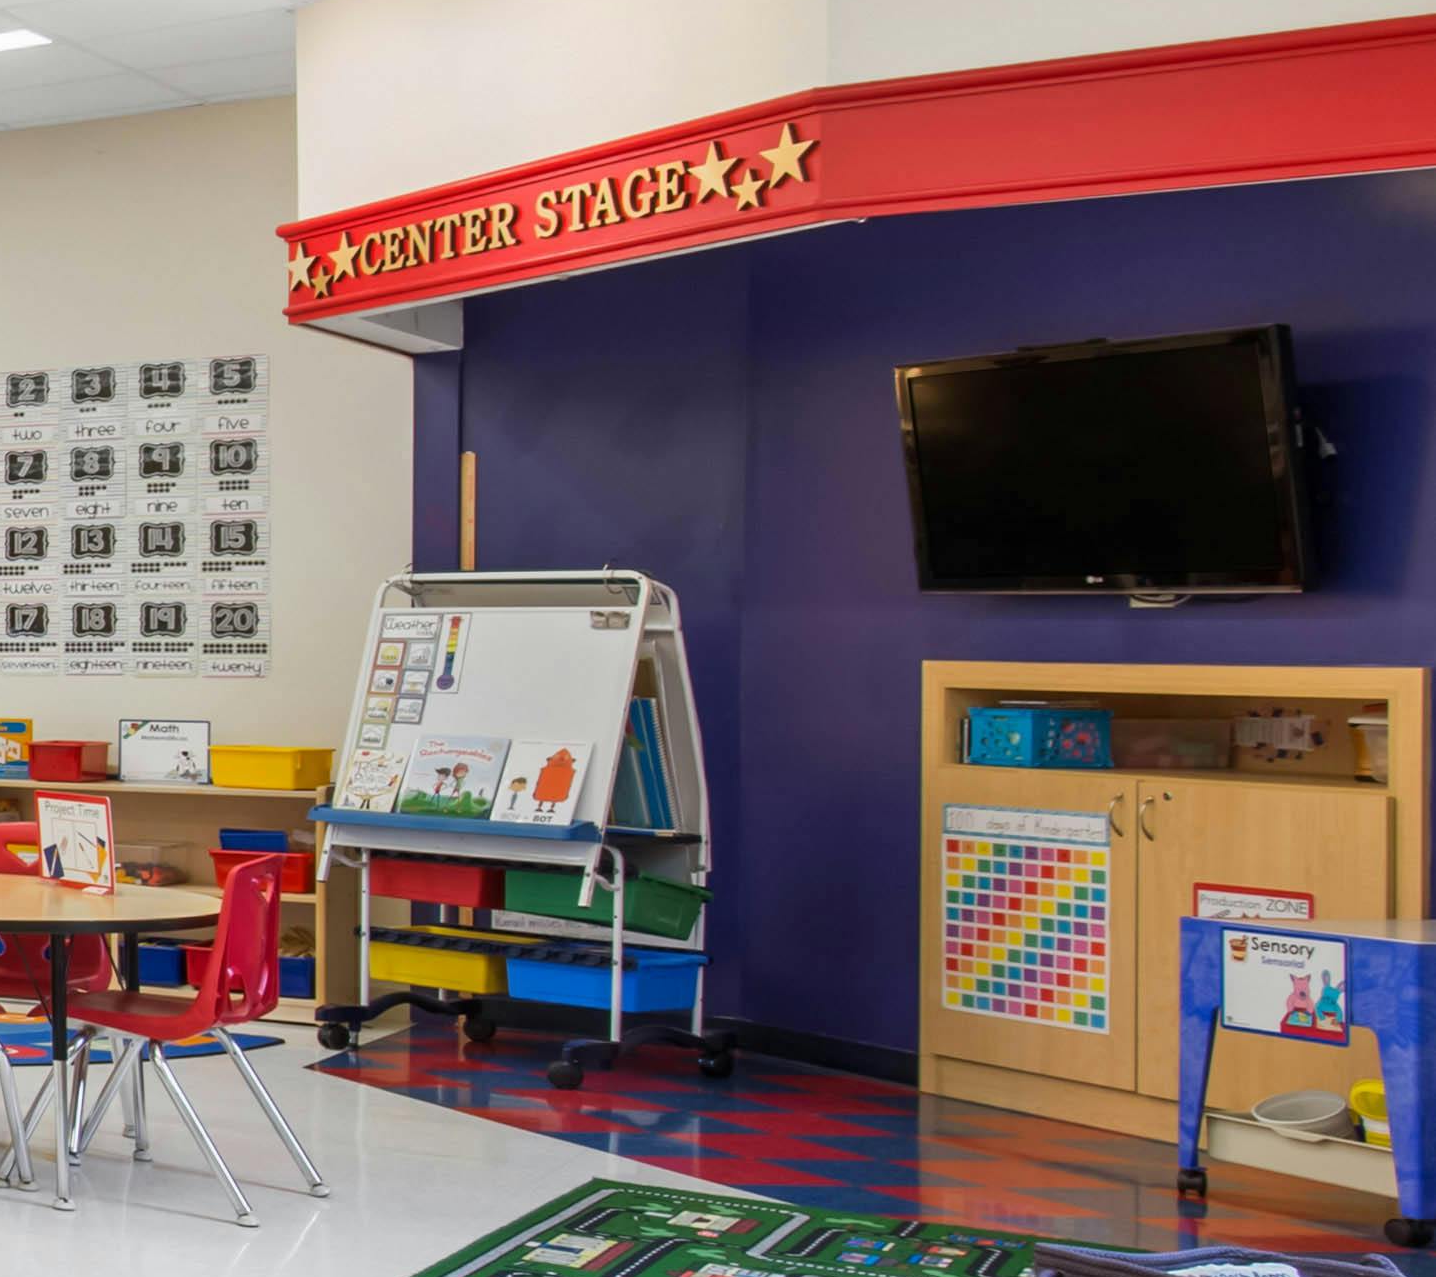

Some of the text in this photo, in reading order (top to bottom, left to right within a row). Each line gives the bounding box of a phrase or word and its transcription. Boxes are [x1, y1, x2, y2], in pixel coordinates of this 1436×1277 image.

[358, 160, 690, 276] CENTER STAGE
[84, 374, 101, 395] 3
[152, 369, 169, 391] 4
[222, 364, 241, 388] 5
[18, 378, 36, 401] 2
[75, 423, 116, 438] three
[146, 420, 178, 434] four
[218, 416, 250, 431] five
[11, 428, 42, 441] two
[83, 452, 100, 474] 8
[152, 449, 170, 471] 9
[219, 444, 247, 468] 10
[18, 455, 35, 478] 7
[4, 506, 50, 519] seven
[76, 502, 111, 519] eight
[147, 500, 178, 513] nine
[221, 498, 249, 511] ten
[13, 533, 37, 555] 12
[80, 530, 103, 552] 13
[147, 528, 174, 550] 14
[221, 525, 246, 549] 15
[3, 582, 53, 595] twelve
[69, 579, 120, 593] thirteen
[135, 579, 191, 592] fourteen
[211, 579, 259, 592] fifteen
[13, 609, 38, 631] 17
[81, 608, 105, 631] 18
[149, 607, 176, 630] 19
[215, 609, 254, 632] 20
[384, 618, 435, 631] Weather
[2, 660, 57, 671] seventeen
[69, 658, 123, 674] eighteen
[135, 658, 192, 671] nineteen
[211, 661, 262, 677] twenty
[149, 723, 180, 734] Math
[44, 800, 100, 819] Project Time
[532, 815, 553, 823] BOT
[1200, 893, 1308, 915] Production ZONE
[1250, 936, 1315, 960] Sensory
